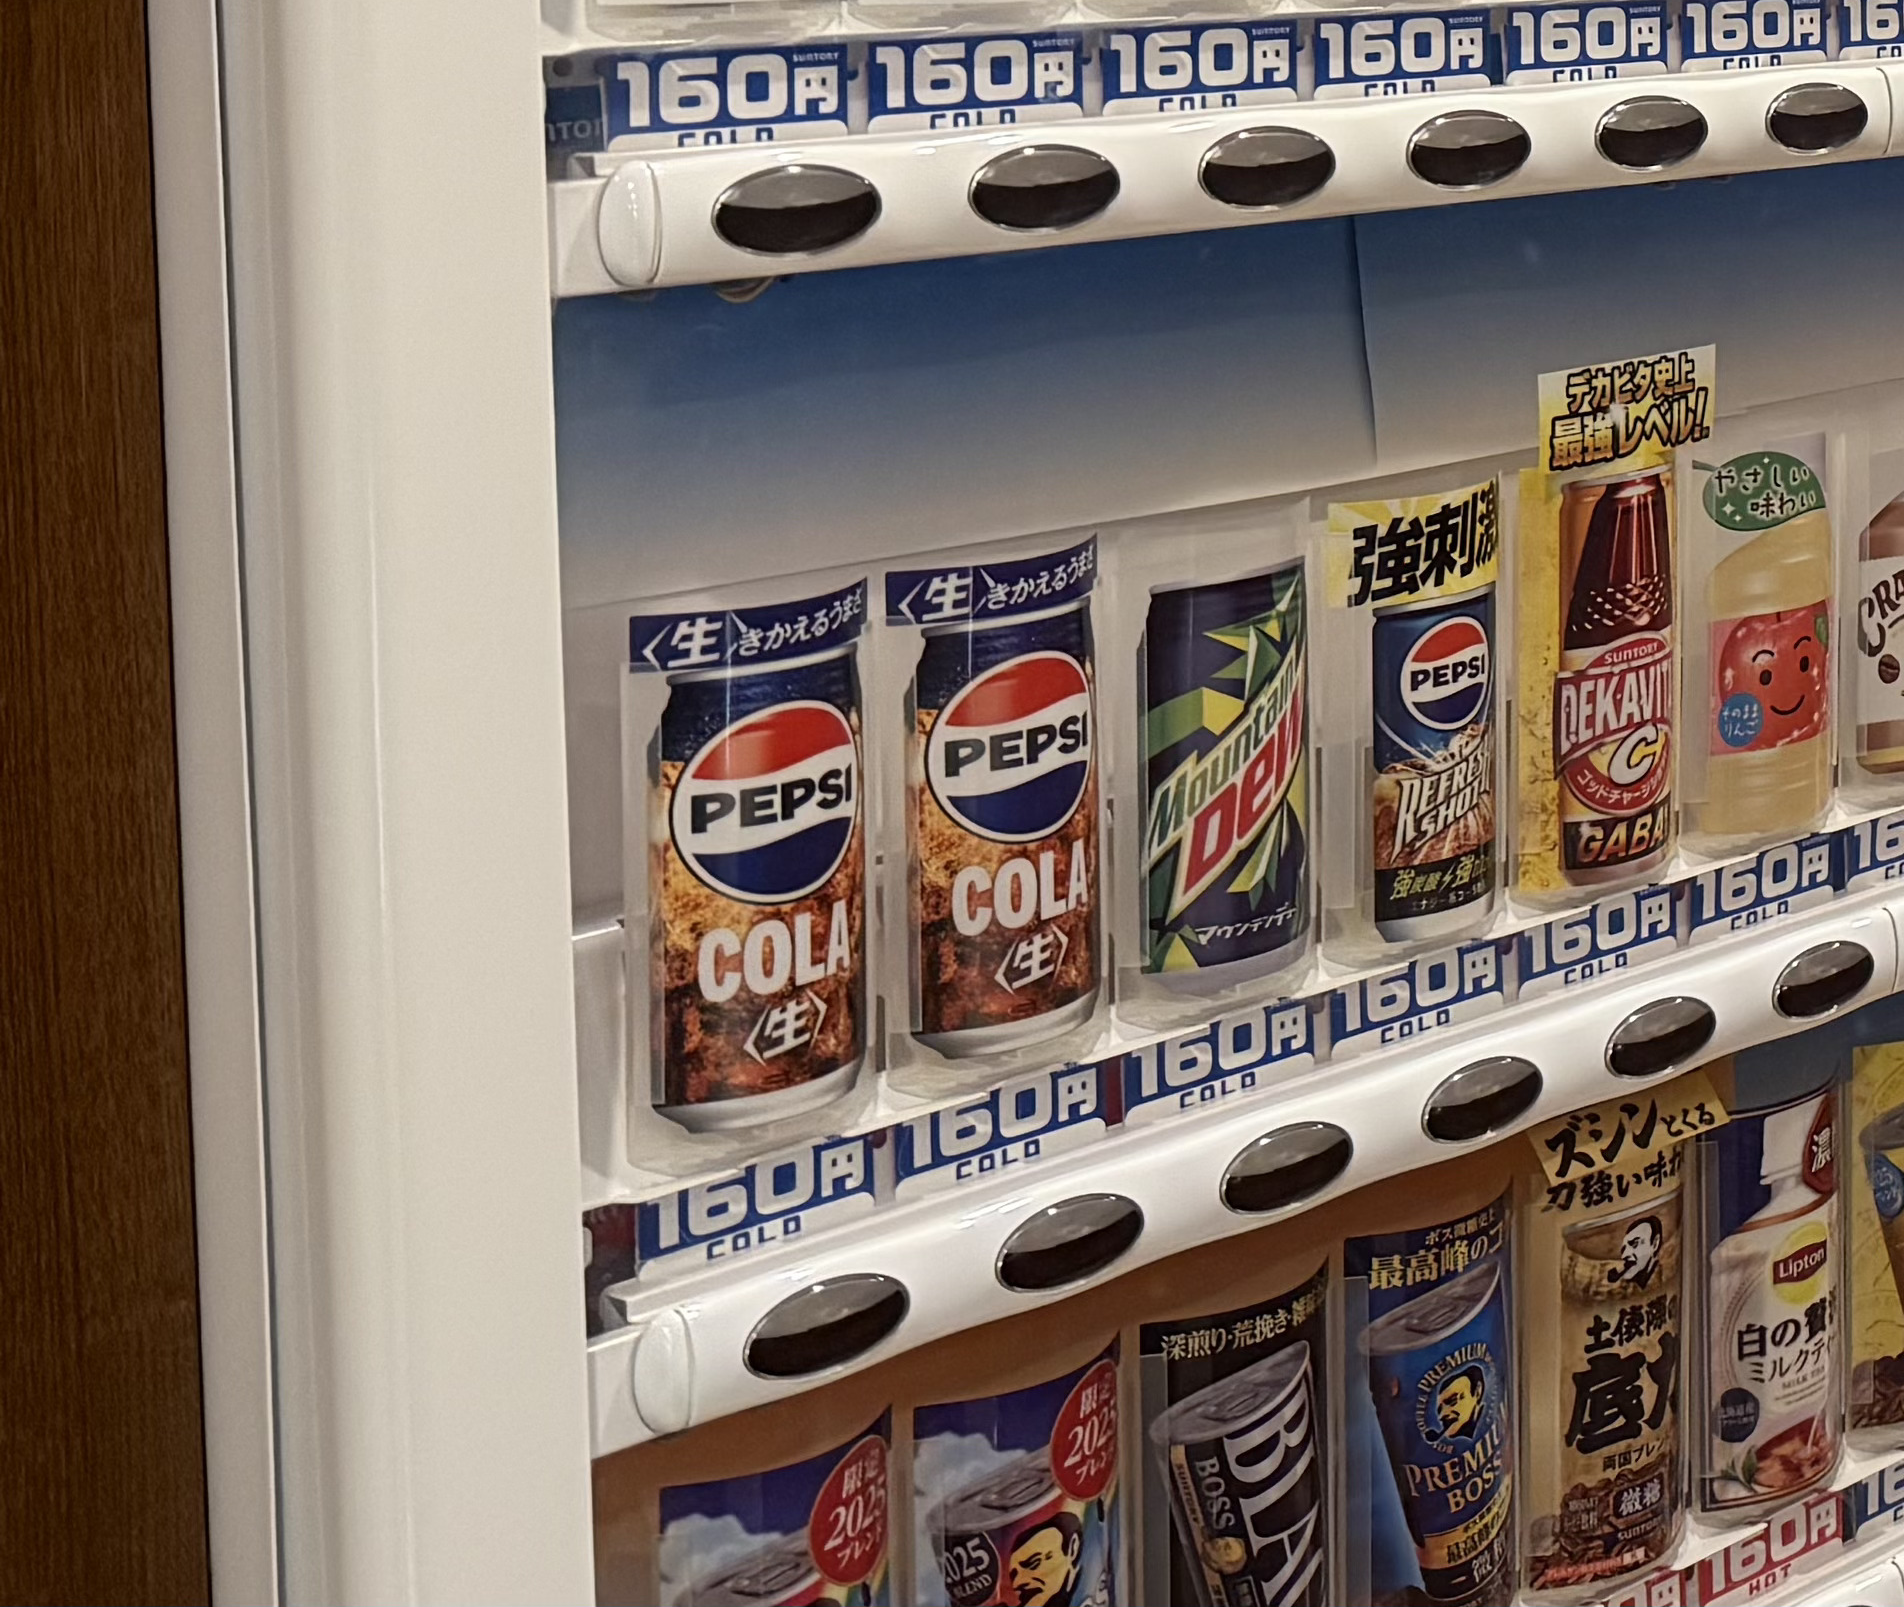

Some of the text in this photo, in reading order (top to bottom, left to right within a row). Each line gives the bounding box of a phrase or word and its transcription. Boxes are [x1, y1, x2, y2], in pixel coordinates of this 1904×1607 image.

[1110, 27, 1290, 94] 160円
[1320, 17, 1485, 80] 160円
[1512, 5, 1661, 65] 160円
[617, 54, 839, 128] 160円
[876, 39, 1074, 109] 160円
[1566, 352, 1695, 415] デカビタ史上
[1715, 464, 1811, 492] やさしい
[1750, 490, 1817, 519] 味わい
[1411, 660, 1486, 692] PEPSI
[944, 708, 1088, 778] PEPSI
[690, 763, 852, 834] PEPSI
[952, 837, 1088, 937] COLA
[1731, 900, 1789, 931] COLD
[697, 900, 851, 1003] COLA
[1525, 890, 1670, 972] 160円
[1337, 945, 1496, 1032] 160円
[1564, 952, 1628, 985] COLD
[1132, 1004, 1306, 1097] 160円
[1381, 1007, 1450, 1044] COLD
[902, 1064, 1098, 1168] 160円
[1180, 1070, 1256, 1108] COLD
[956, 1138, 1040, 1180] COLD
[646, 1136, 864, 1249] 160円
[706, 1215, 801, 1260] COLD
[1778, 1246, 1827, 1282] Lipton
[1196, 1456, 1235, 1531] BOSS
[1748, 1565, 1790, 1598] HOT
